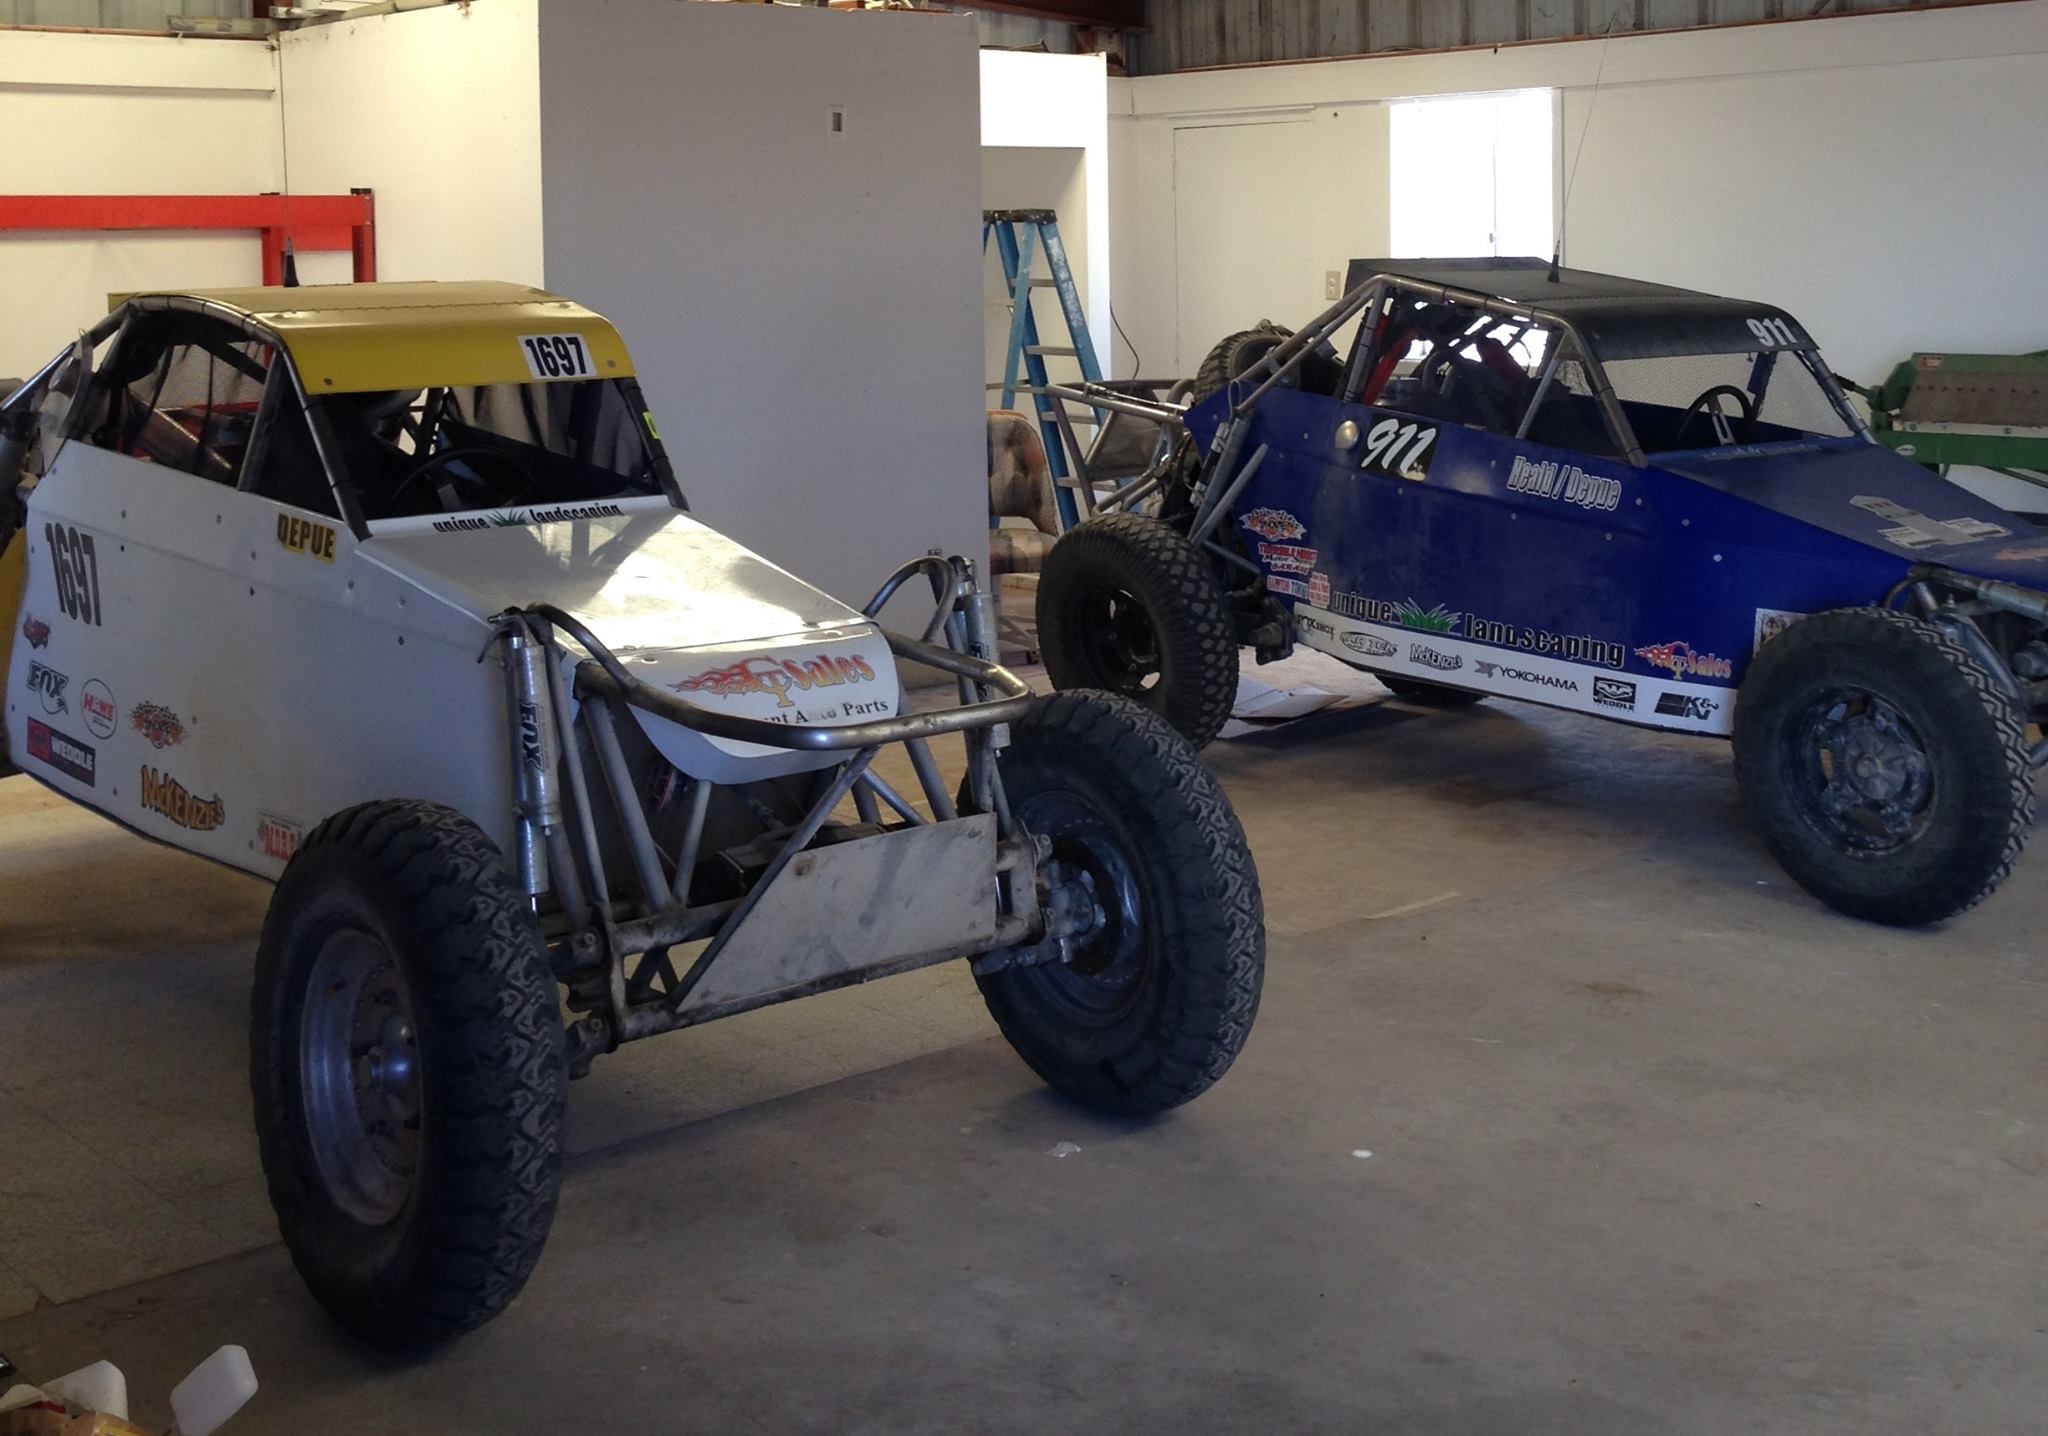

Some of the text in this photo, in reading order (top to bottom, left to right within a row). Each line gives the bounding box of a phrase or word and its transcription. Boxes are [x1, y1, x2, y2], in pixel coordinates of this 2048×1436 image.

[1746, 317, 1798, 347] 911
[525, 336, 587, 377] 1697
[1361, 418, 1437, 473] 911
[1564, 466, 1621, 511] Depue
[276, 513, 336, 559] DEPUE
[45, 522, 102, 627] 1697
[1333, 591, 1393, 623] unique
[27, 660, 69, 703] FOX
[781, 654, 875, 690] Sales
[1500, 666, 1578, 692] YOKOHAMA
[1687, 650, 1732, 679] Sales
[843, 698, 888, 717] Parts
[1593, 696, 1635, 711] WEDDLE
